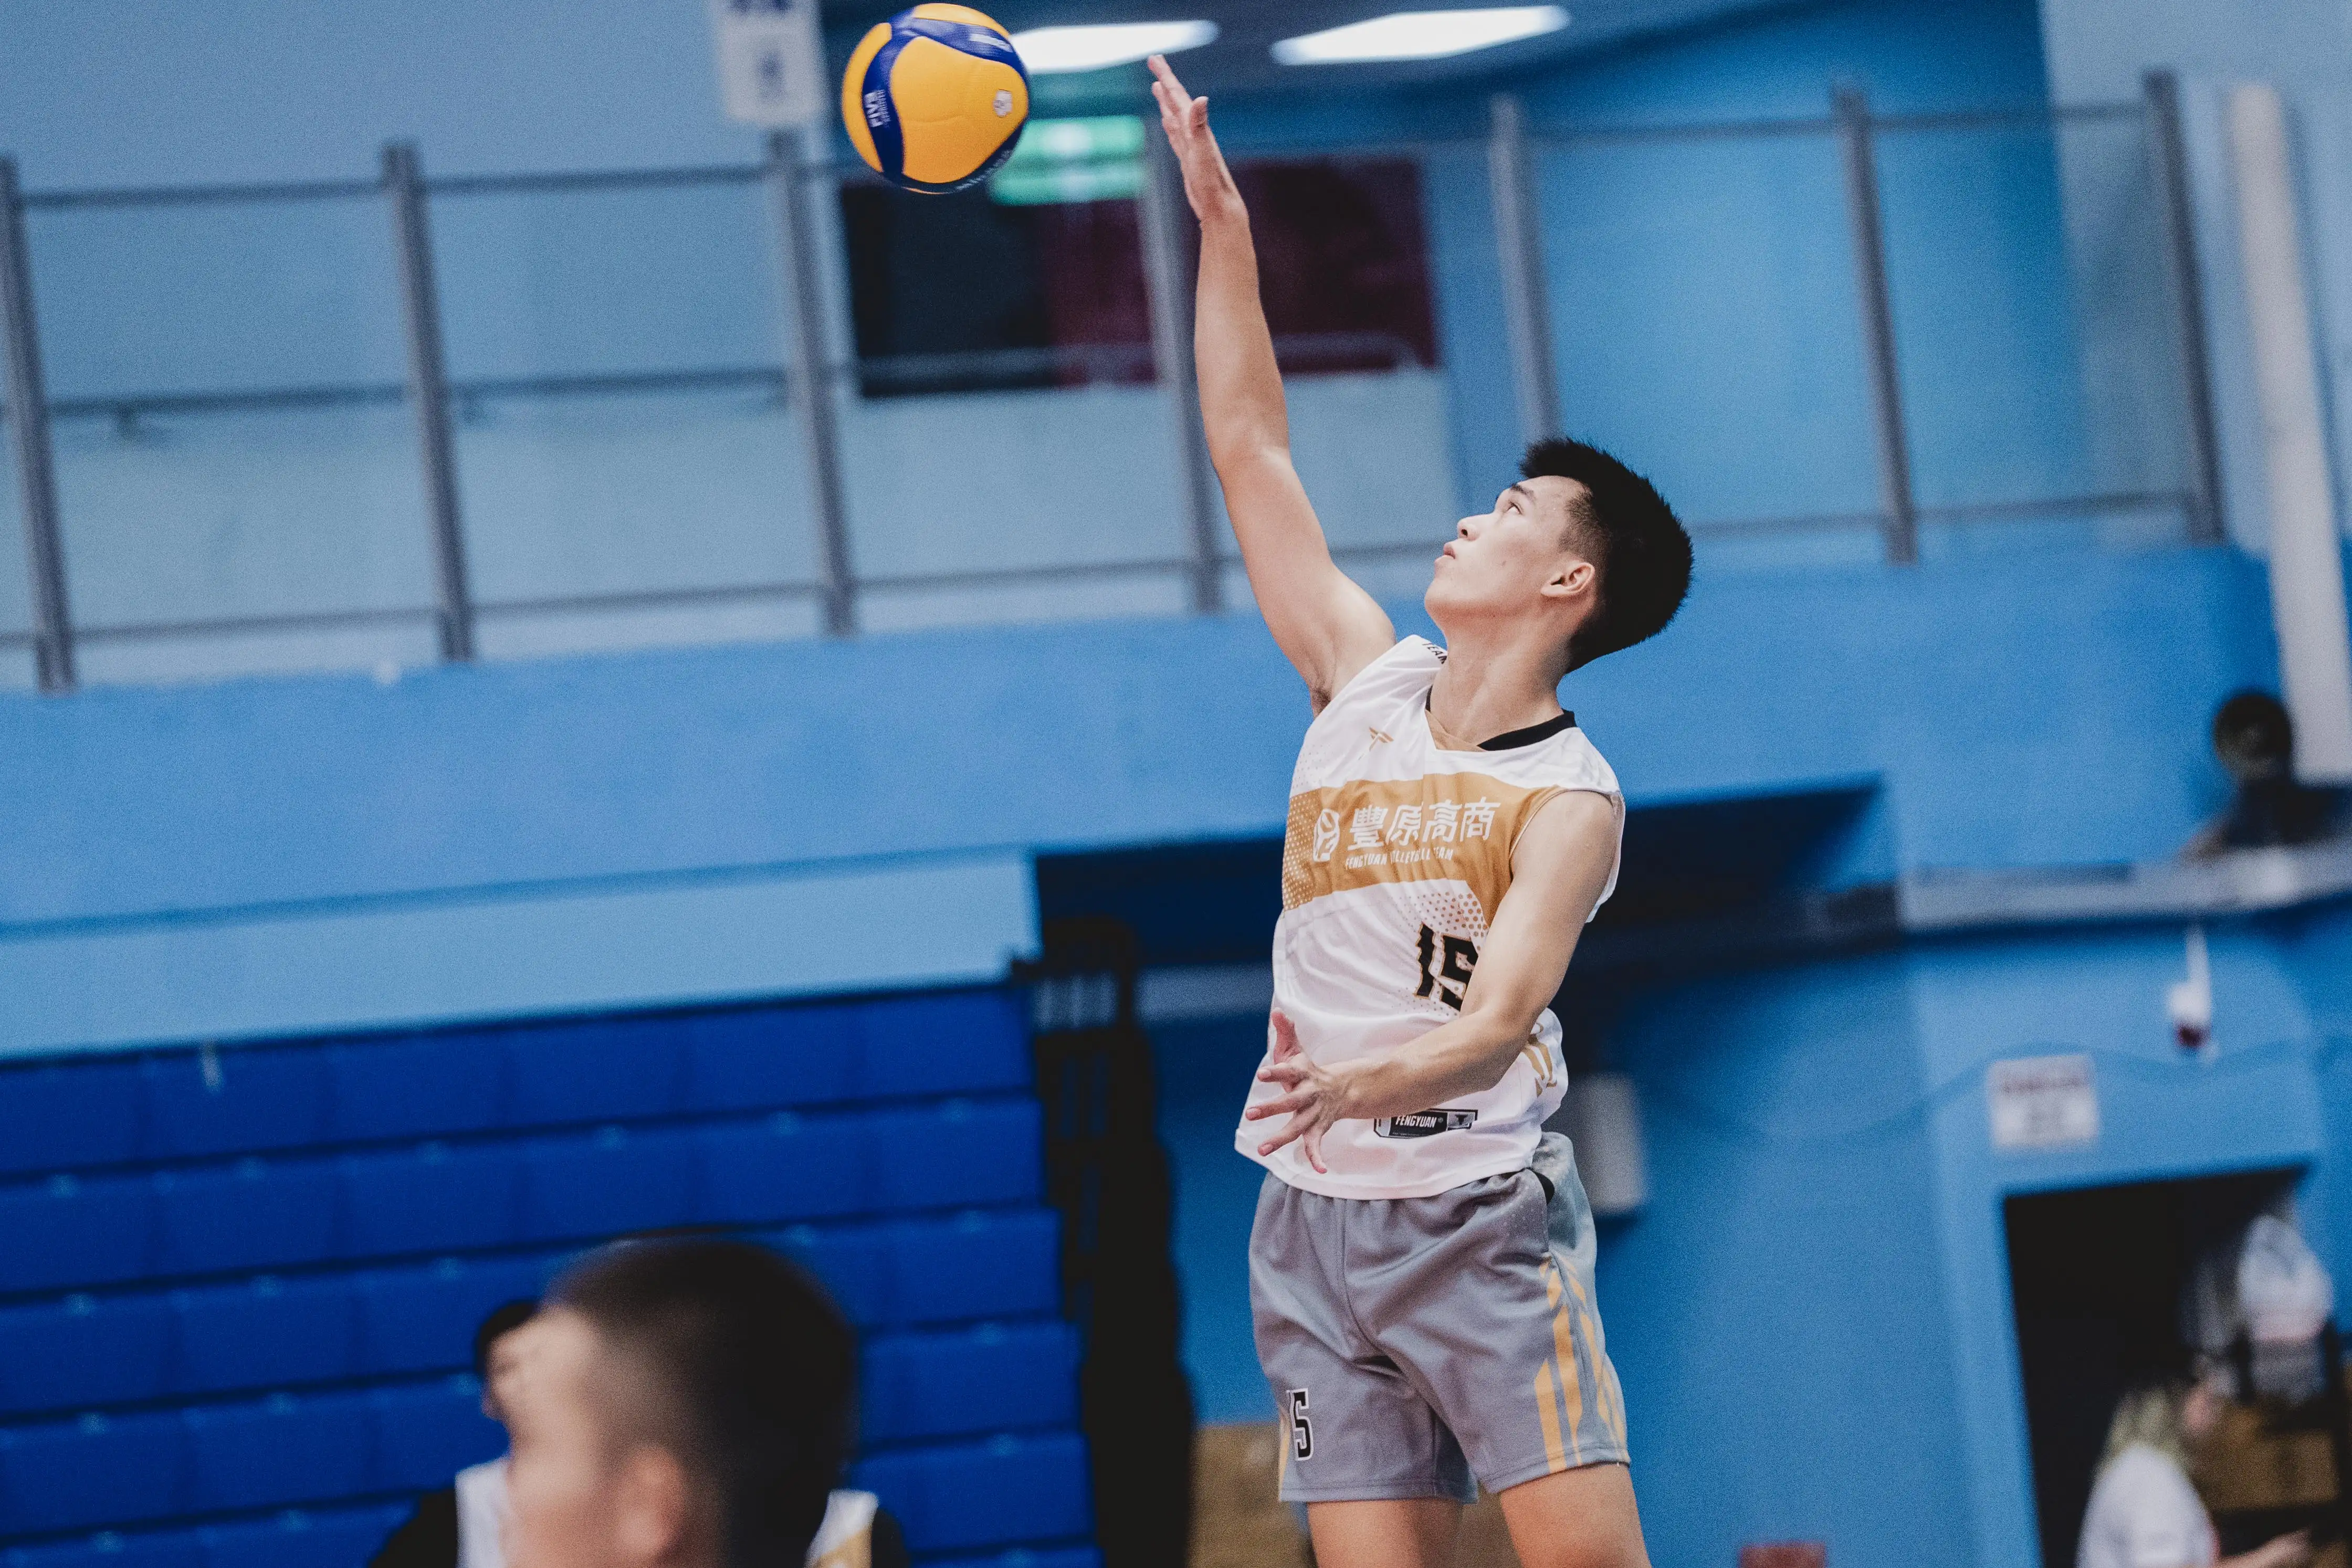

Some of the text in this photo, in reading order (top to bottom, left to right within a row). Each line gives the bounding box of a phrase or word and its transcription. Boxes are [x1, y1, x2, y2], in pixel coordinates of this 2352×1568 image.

[1347, 796, 1501, 851] 豐原高商
[1346, 854, 1388, 869] FENGYUAN
[1414, 922, 1479, 1012] 15
[1395, 1115, 1436, 1128] FENGYUAN
